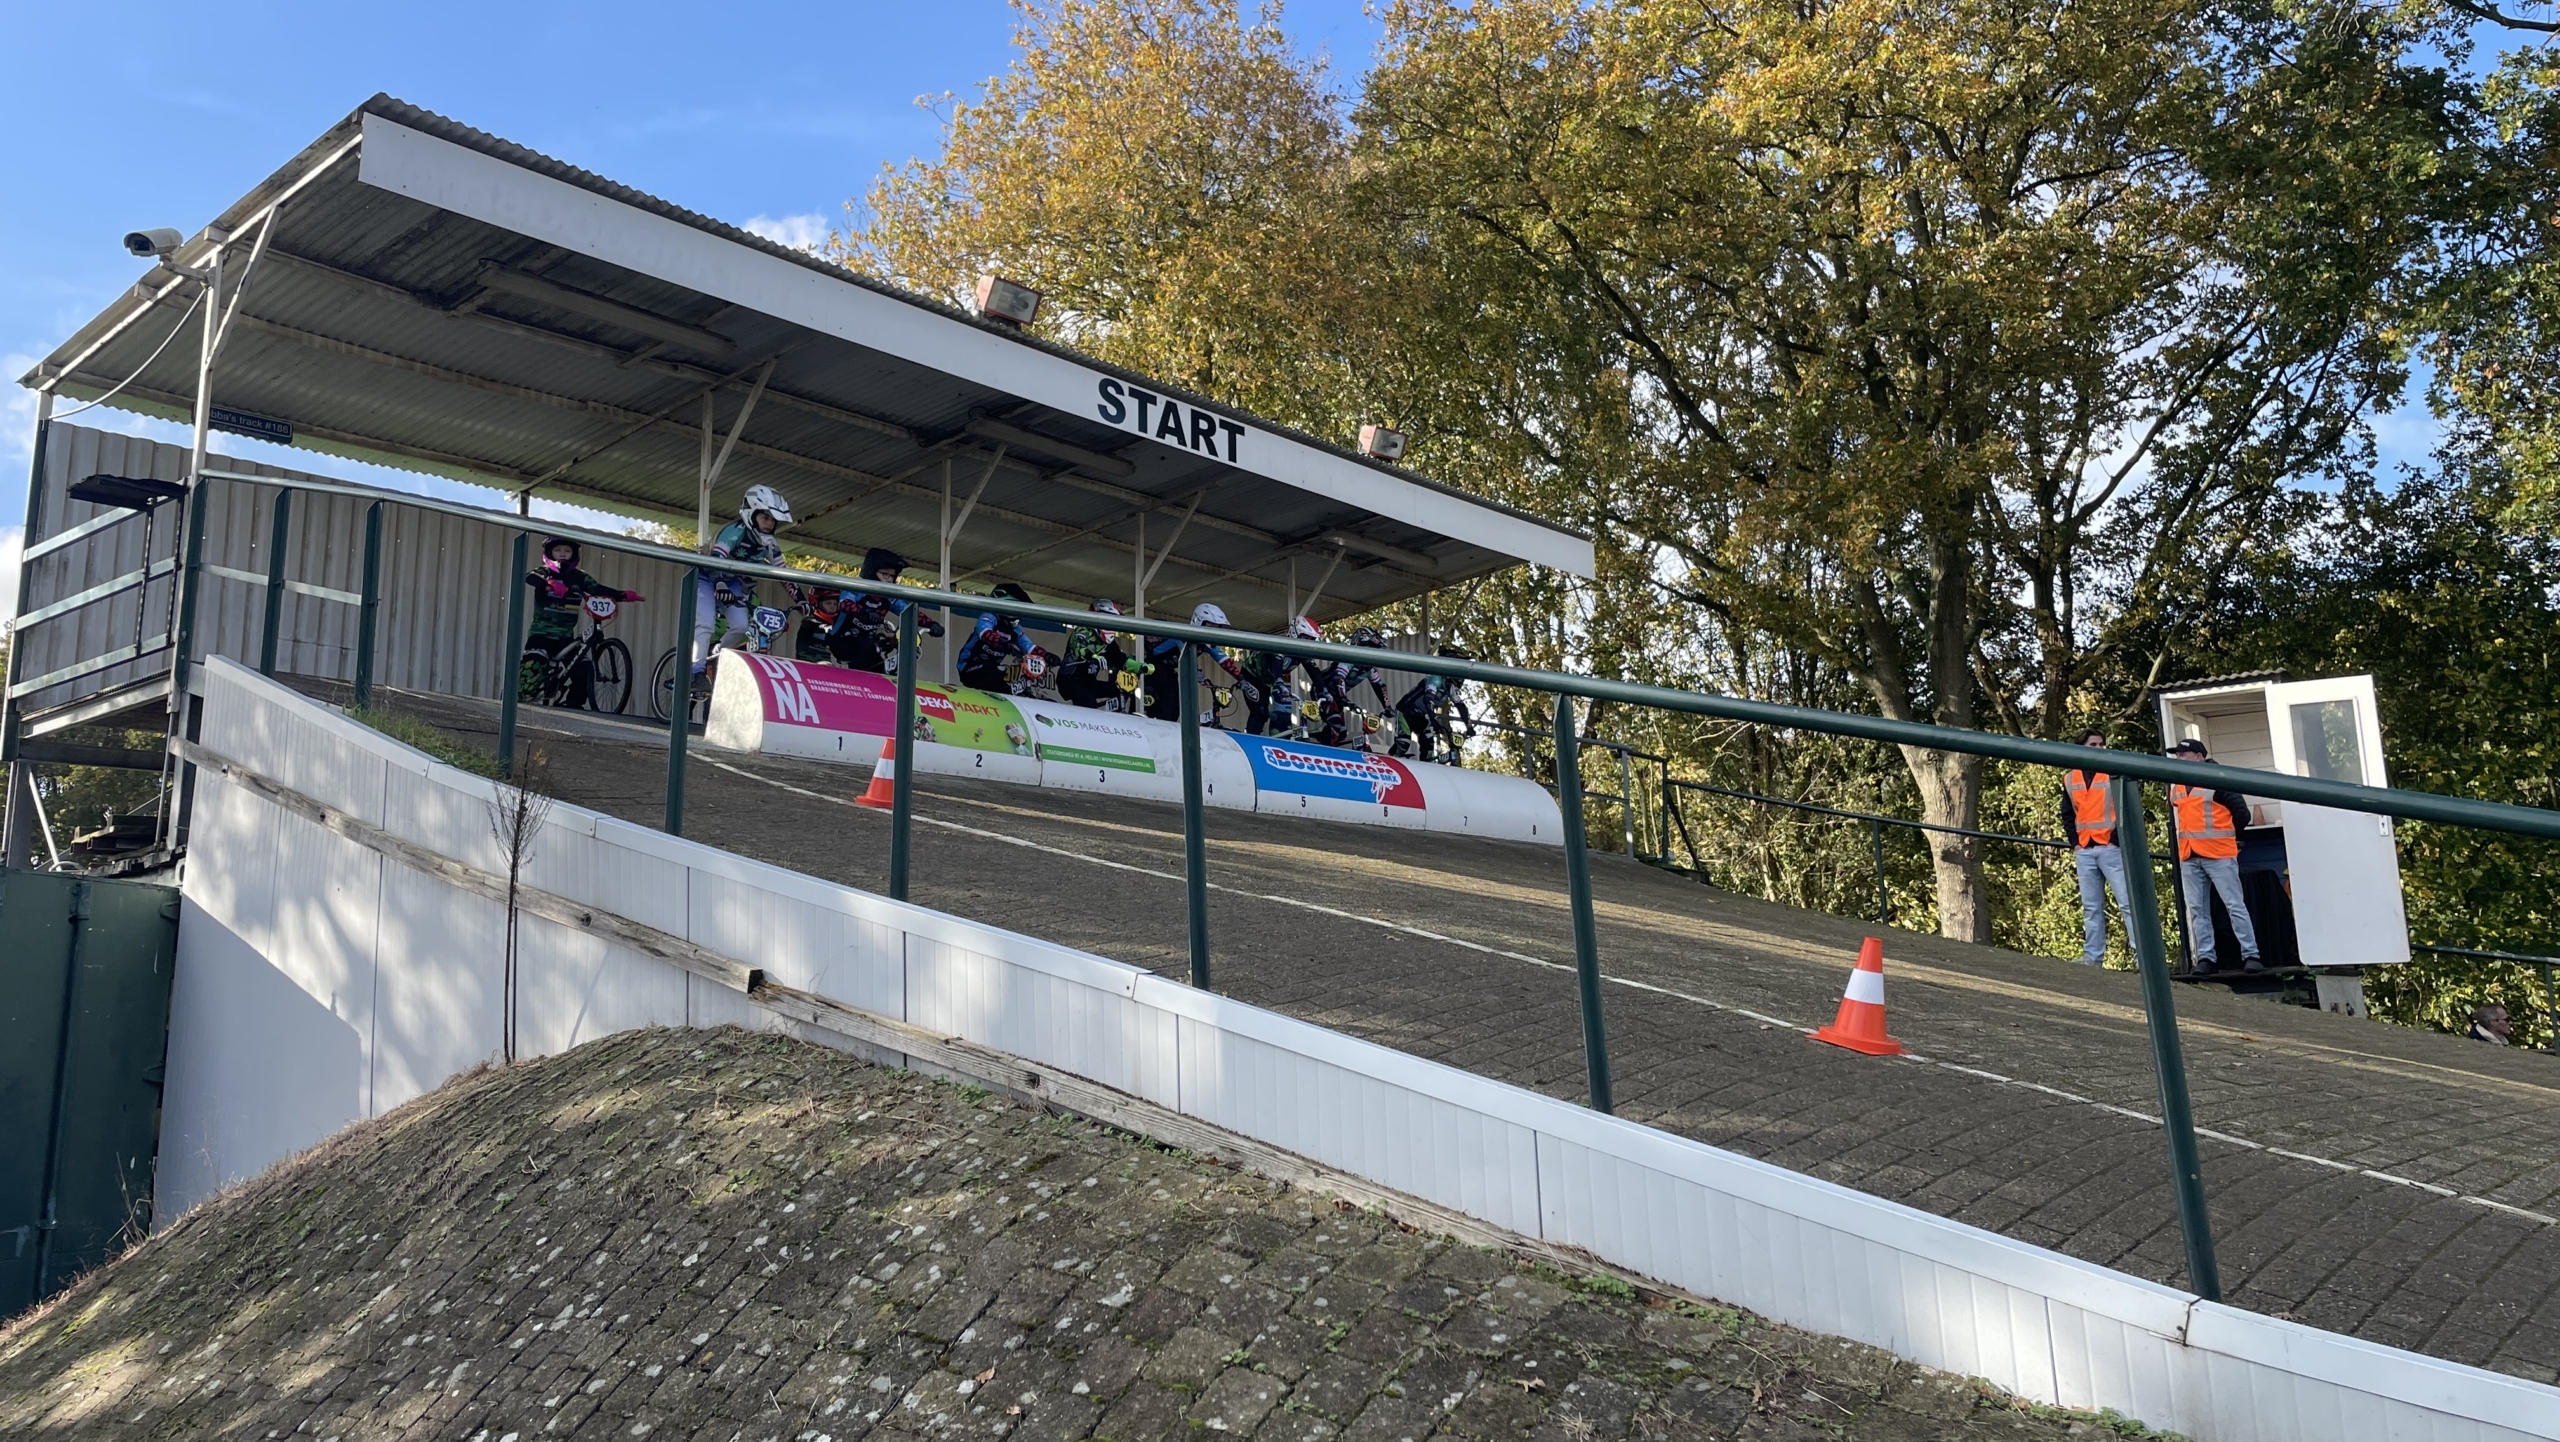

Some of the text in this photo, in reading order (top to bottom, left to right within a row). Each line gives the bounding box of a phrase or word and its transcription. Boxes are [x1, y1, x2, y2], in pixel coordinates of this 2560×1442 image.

[239, 416, 262, 428] track
[1097, 378, 1245, 463] START
[591, 600, 611, 613] 937
[763, 613, 781, 629] 735
[1122, 674, 1134, 687] 114
[770, 679, 820, 724] NA
[1220, 691, 1227, 703] 71
[1203, 712, 1211, 720] 71
[1053, 717, 1142, 739] VOS MAKELAARS
[838, 736, 843, 751] 1
[975, 753, 983, 768] 2
[1099, 769, 1105, 783] 3
[1381, 773, 1398, 783] BMX
[1207, 783, 1213, 796] 4
[1301, 796, 1306, 808] 5
[1383, 806, 1389, 817] 6
[1463, 816, 1468, 826] 7
[1532, 824, 1537, 836] 8
